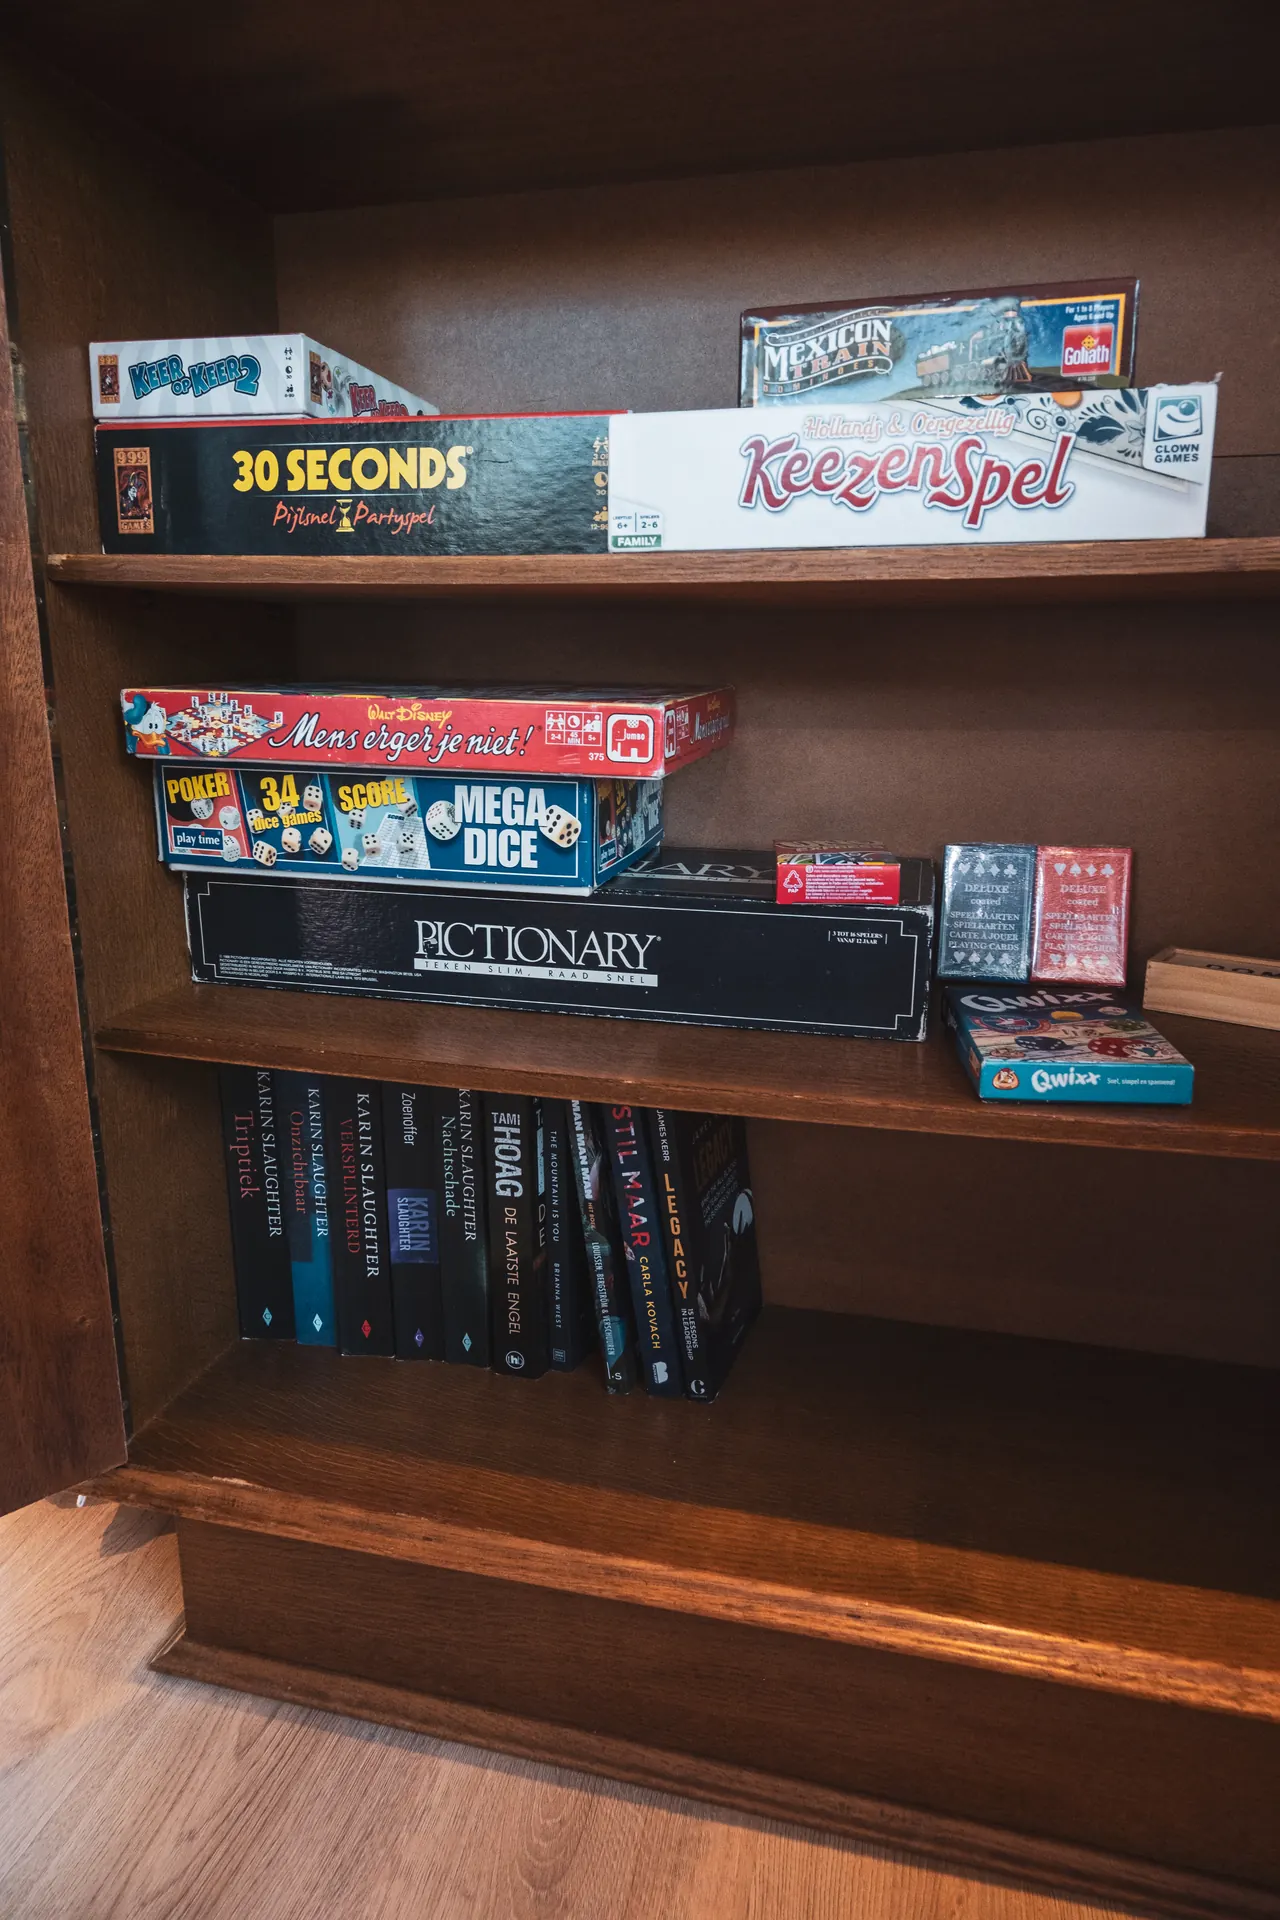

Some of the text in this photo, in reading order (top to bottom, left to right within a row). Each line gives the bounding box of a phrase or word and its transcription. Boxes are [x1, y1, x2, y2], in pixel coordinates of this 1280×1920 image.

[789, 341, 892, 379] TRAIN
[1064, 344, 1110, 366] Goliath
[128, 354, 261, 399] KEER OP KEER 2
[763, 360, 875, 394] DOMINOES
[804, 409, 1017, 441] Hollands & Oergezellig
[116, 450, 148, 464] 999
[1154, 453, 1200, 464] GAMES
[1155, 443, 1201, 454] CLOWN
[231, 445, 467, 493] 30 SECONDS
[595, 488, 607, 496] 30
[120, 521, 151, 531] GAMES
[272, 500, 437, 535] Pijlsnel Partyspel
[617, 536, 658, 547] FAMILY
[268, 712, 535, 764] Mens erger je niet!
[550, 733, 562, 741] 2-4
[567, 737, 581, 745] MIN
[587, 734, 597, 742] 5+
[588, 752, 605, 762] 375
[166, 771, 231, 804] POKER
[260, 774, 301, 812] 34
[338, 777, 409, 812] SCORE
[253, 810, 323, 831] dice games
[454, 785, 549, 828] MEGA
[176, 831, 221, 847] play time
[463, 827, 539, 869] DICE
[964, 884, 1010, 894] DELUXE
[1060, 884, 1107, 894] DELUXE
[950, 911, 1020, 921] SPEELKAARTEN
[953, 921, 1016, 931] SPIELKARTEN
[414, 919, 657, 971] PICTIONARY
[948, 941, 1020, 951] PLAYING CARDS
[949, 931, 980, 940] CARTE
[990, 932, 1019, 941] JOUER
[424, 960, 472, 972] TEKEN
[488, 964, 531, 976] SLIM,
[548, 969, 589, 980] RAAD
[606, 973, 645, 985] SNEL
[960, 990, 1114, 1013] Qwixx
[1030, 1066, 1102, 1093] Qwixx
[401, 1092, 418, 1146] Zoenoffer
[491, 1112, 521, 1126] TAMI
[656, 1110, 670, 1162] JAMES KERR
[229, 1110, 261, 1199] Triptiek
[256, 1070, 283, 1238] KARIN SLAUGHTER
[289, 1111, 309, 1215] Onzichtbaar
[307, 1088, 329, 1238] KARIN SLAUGHTER
[441, 1115, 461, 1218] Nachtschade
[459, 1088, 476, 1242] KARIN SLAUGHTER
[494, 1126, 524, 1198] HOAG
[571, 1100, 593, 1201] MAN MAN MAN
[339, 1118, 361, 1254] VERSPLINTERD
[356, 1093, 380, 1278] KARIN SLAUGHTER
[550, 1130, 560, 1242] THE MOUNTAIN IS YOU
[611, 1104, 650, 1247] STIL MAAR
[397, 1196, 411, 1252] SLAUGHTER
[408, 1197, 431, 1252] KARIN
[504, 1206, 518, 1225] DE
[663, 1173, 689, 1300] LEGACY
[505, 1231, 519, 1286] LAATSTE
[553, 1262, 561, 1301] BRIANNA
[507, 1292, 521, 1335] ENGEL
[639, 1255, 653, 1297] CARLA
[646, 1301, 661, 1349] KOVACH
[681, 1308, 694, 1361] IN LEADERSHIP
[688, 1316, 699, 1349] LESSONS
